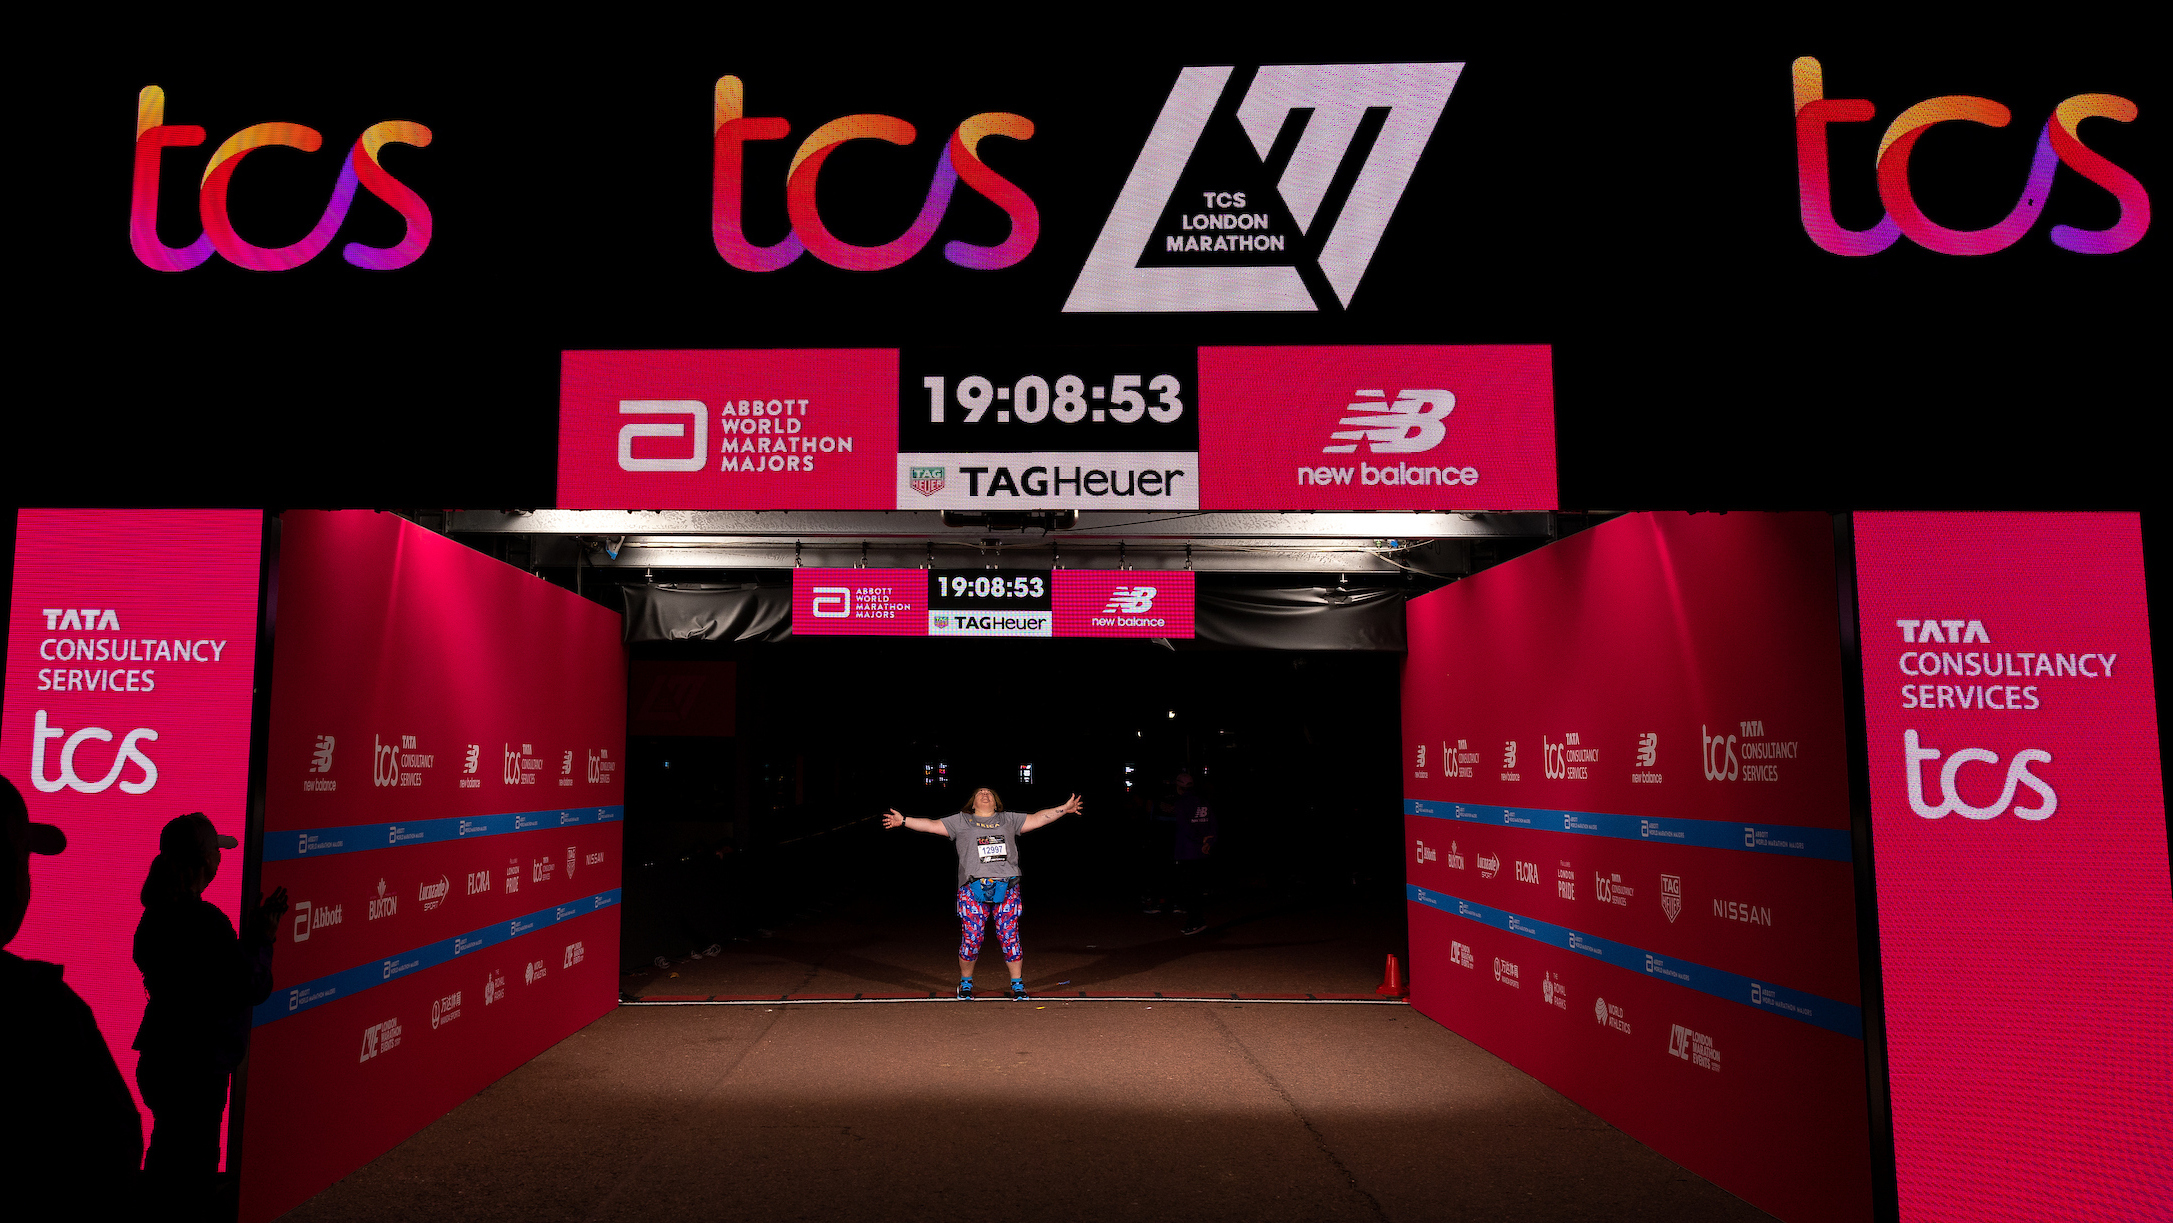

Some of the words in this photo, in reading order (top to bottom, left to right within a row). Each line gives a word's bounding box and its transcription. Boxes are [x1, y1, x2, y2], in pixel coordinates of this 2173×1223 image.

[1792, 56, 2151, 256] tcs
[130, 85, 432, 272] tcs
[712, 75, 1039, 271] tcs
[1203, 192, 1246, 209] TCS
[1182, 213, 1268, 230] LONDON
[1166, 235, 1285, 252] MARATHON
[721, 400, 809, 416] ABBOTT
[923, 375, 1183, 423] 19:08:53
[721, 419, 802, 435] WORLD
[720, 437, 853, 453] MARATHON
[720, 456, 814, 472] MAJORS
[913, 470, 943, 479] TAG
[1298, 468, 1353, 486] new
[1361, 462, 1479, 486] balance
[911, 480, 945, 495] HEUER
[938, 577, 1044, 598] 19:08:53
[856, 595, 890, 603] WORLD
[856, 603, 911, 611] MARATHON
[42, 609, 120, 630] TATA
[1092, 618, 1115, 627] new
[1117, 616, 1165, 627] balance
[1896, 620, 1990, 643] TATA
[40, 638, 227, 662] CONSULTANCY
[1899, 652, 2117, 677] CONSULTANCY
[37, 668, 155, 692] SERVICES
[1901, 684, 2039, 709] SERVICES
[1740, 720, 1764, 737] TATA
[402, 735, 416, 749] TATA
[1566, 732, 1580, 745] TATA
[31, 709, 158, 794] tcs
[1443, 740, 1458, 777] tcs
[1544, 735, 1565, 780] tcs
[1566, 749, 1599, 762] CONSULTANCY
[1702, 724, 1738, 781] tcs
[1741, 741, 1798, 759] CONSULTANCY
[374, 733, 399, 787] tcs
[401, 754, 434, 768] CONSULTANCY
[504, 742, 520, 784] tcs
[588, 749, 599, 783] tcs
[400, 773, 421, 786] SERVICES
[1567, 767, 1588, 780] SERVICES
[1632, 774, 1642, 783] new
[1642, 771, 1662, 783] balance
[1742, 765, 1778, 781] SERVICES
[1904, 729, 2057, 820] tcs
[304, 780, 314, 791] new
[315, 778, 336, 791] balance
[586, 852, 604, 866] NISSAN
[982, 846, 1003, 855] 12997
[1516, 861, 1539, 885] FLORA
[1557, 869, 1574, 880] LONDON
[419, 879, 446, 901] Lucozade
[467, 870, 490, 895] FLORA
[1558, 880, 1575, 901] PRIDE
[1595, 871, 1611, 903] tcs
[1662, 878, 1679, 894] TAG
[369, 896, 397, 920] BUXTON
[424, 900, 439, 911] SPORT
[1713, 899, 1771, 926] NISSAN
[312, 904, 342, 929] Abbott
[1608, 1003, 1624, 1019] WORLD
[1608, 1016, 1631, 1035] ATHLETICS
[1692, 1031, 1713, 1048] LONDON
[1692, 1041, 1721, 1062] MARATHON
[1692, 1052, 1711, 1070] EVENTS
